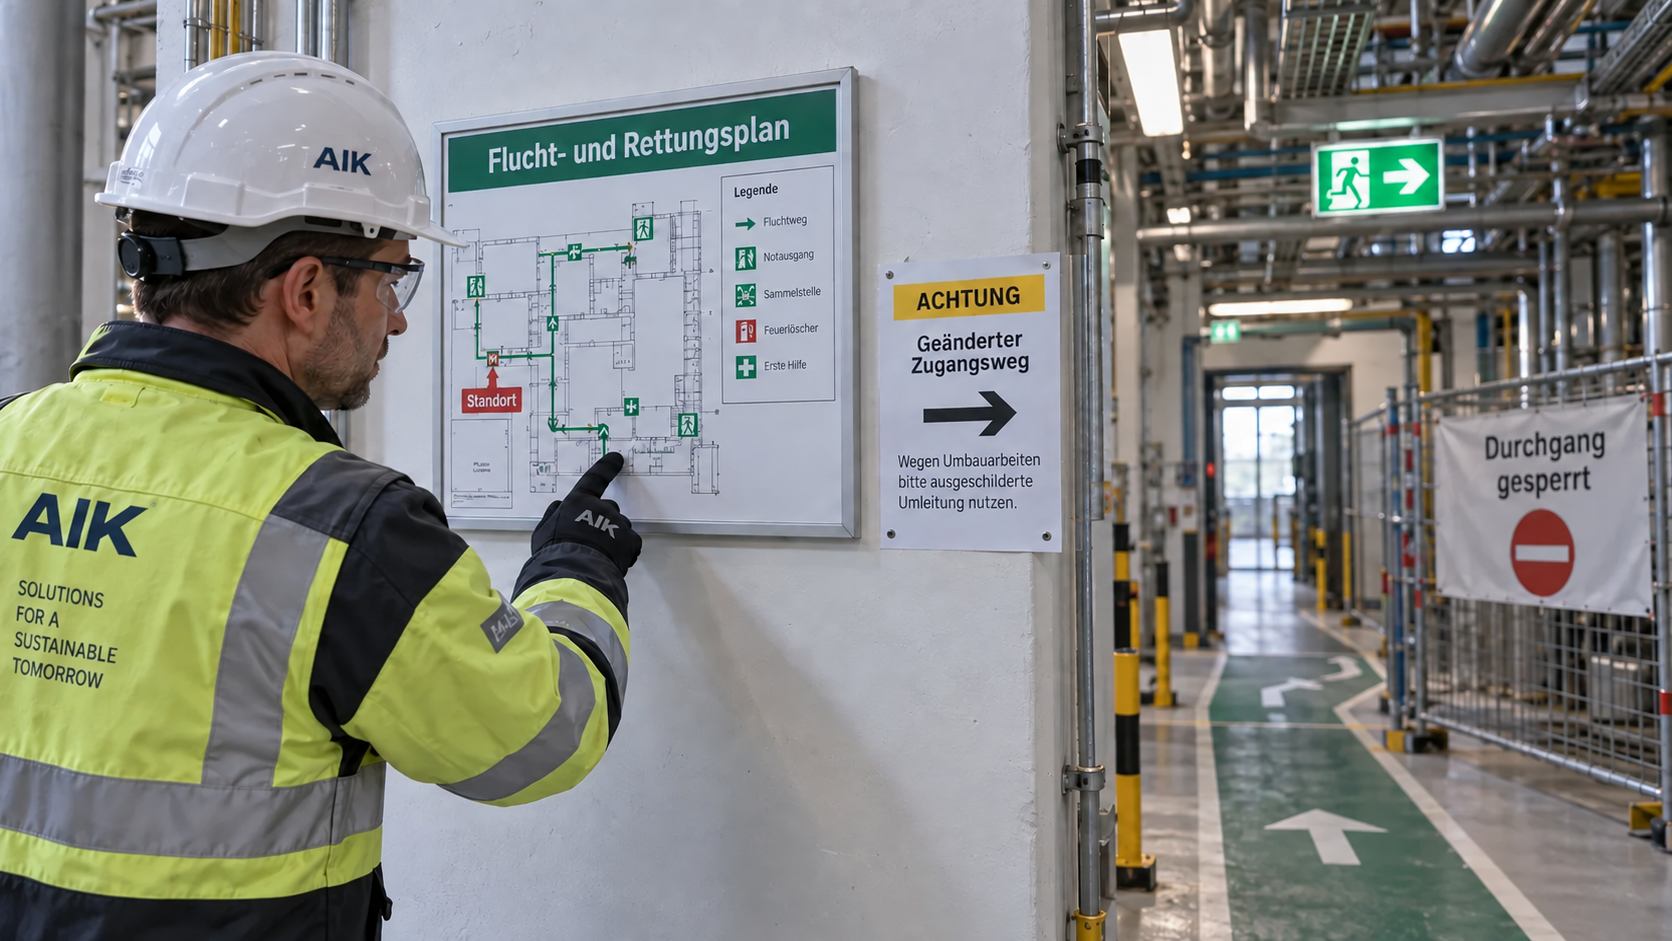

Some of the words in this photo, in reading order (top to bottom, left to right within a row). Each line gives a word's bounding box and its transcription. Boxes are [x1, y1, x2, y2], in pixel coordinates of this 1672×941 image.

[488, 144, 567, 174] Flucht-
[573, 135, 616, 162] und
[624, 116, 790, 158] Rettungsplan
[313, 146, 372, 176] AIK
[734, 183, 778, 198] Legende
[763, 214, 807, 229] Fluchtweg
[763, 248, 815, 264] Notausgang
[763, 285, 821, 299] Sammelstelle
[916, 286, 1021, 311] ACHTUNG
[764, 322, 819, 335] Feuerlöscher
[917, 331, 1023, 353] Geänderter
[764, 360, 786, 371] Erste
[788, 359, 807, 371] Hilfe
[911, 354, 1030, 377] Zugangsweg
[466, 392, 517, 408] Standort
[1485, 430, 1605, 462] Durchgang
[898, 454, 940, 471] Wegen
[943, 453, 1041, 467] Umbauarbeiten
[898, 475, 927, 488] bitte
[930, 474, 1033, 491] ausgeschilderte
[1497, 466, 1591, 499] gesperrt
[898, 496, 964, 512] Umleitung
[968, 496, 1018, 509] nutzen.
[11, 492, 148, 558] AIK
[575, 509, 620, 539] AIK
[17, 579, 105, 609] SOLUTIONS
[16, 605, 44, 625] FOR
[48, 610, 60, 628] A
[14, 631, 118, 664] SUSTAINABLE
[12, 657, 104, 689] TOMORROW
